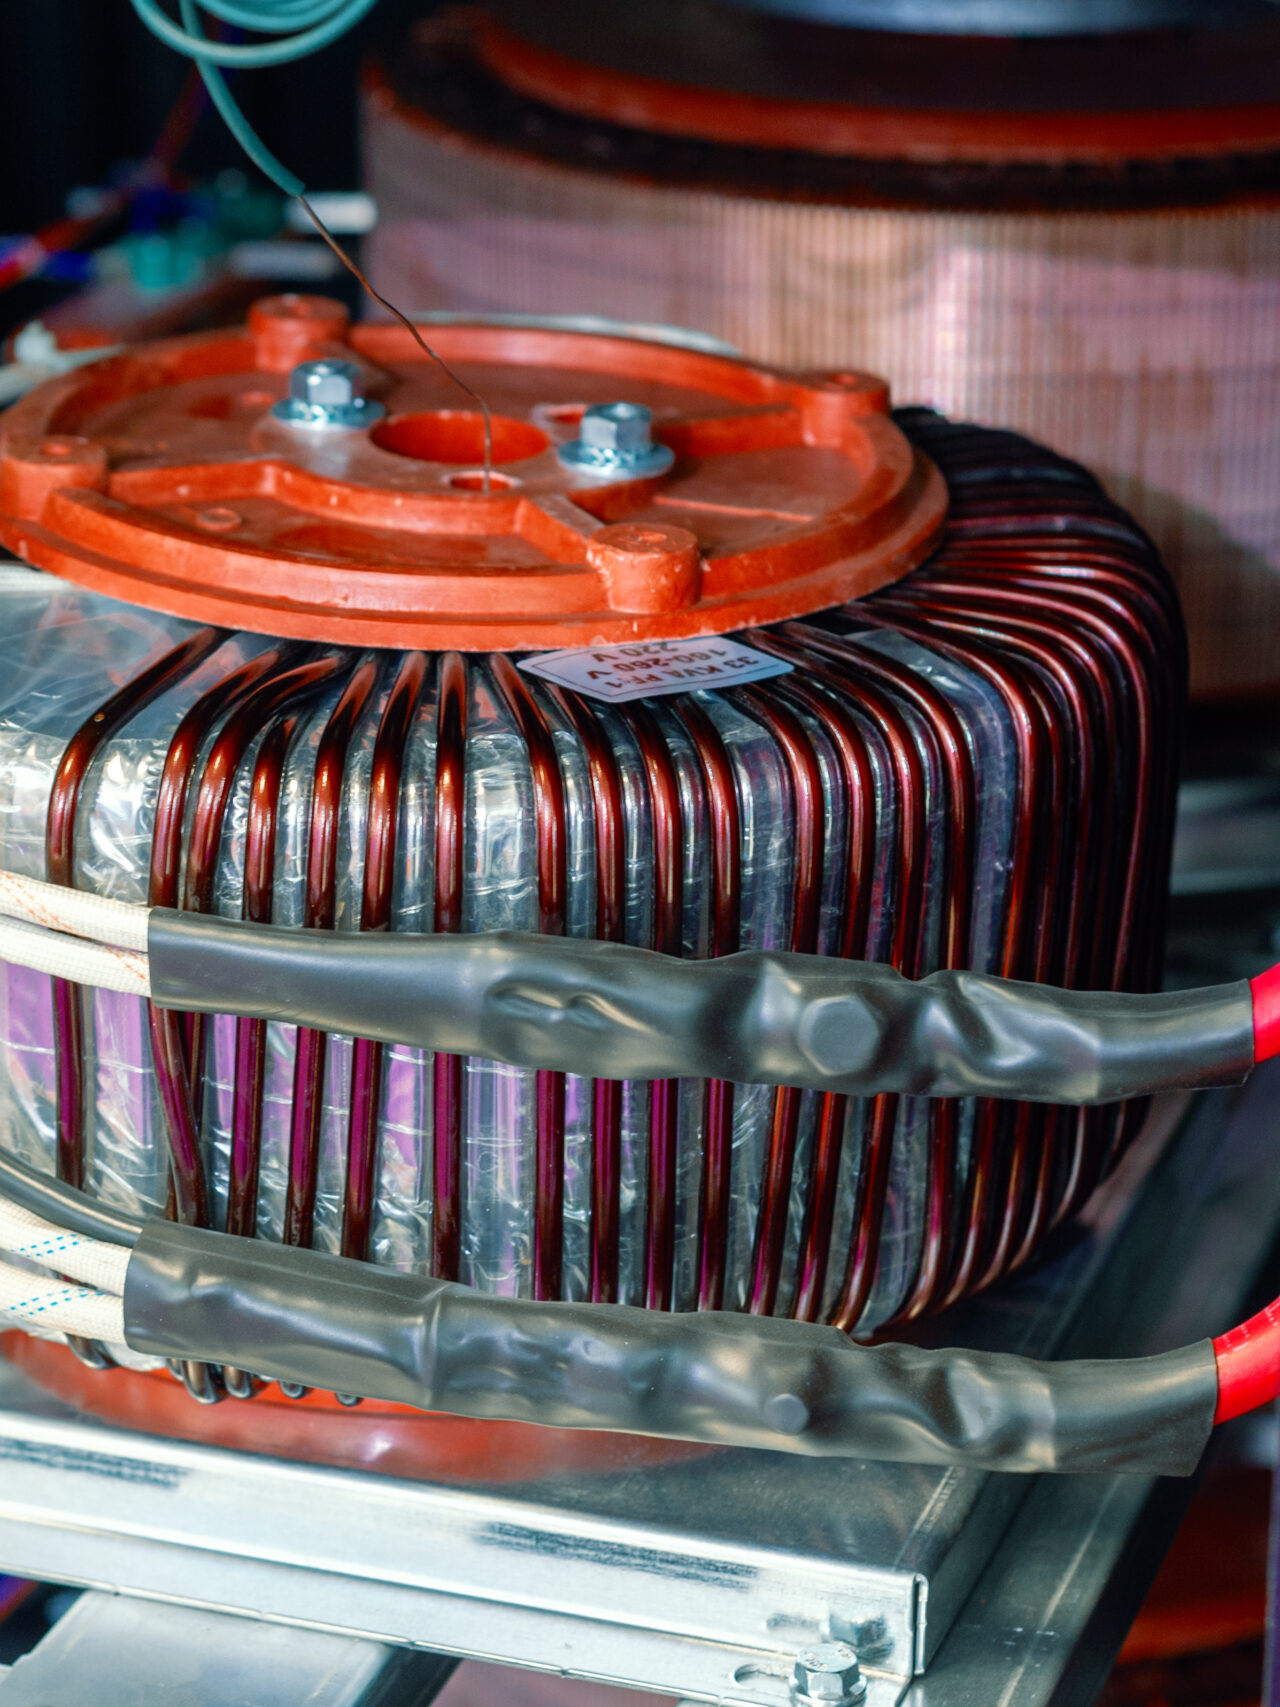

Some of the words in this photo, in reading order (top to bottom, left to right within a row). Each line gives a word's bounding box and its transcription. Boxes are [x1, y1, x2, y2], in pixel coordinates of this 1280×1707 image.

[619, 642, 679, 657] 220
[591, 652, 616, 662] V
[723, 655, 760, 670] 33
[587, 670, 612, 680] V
